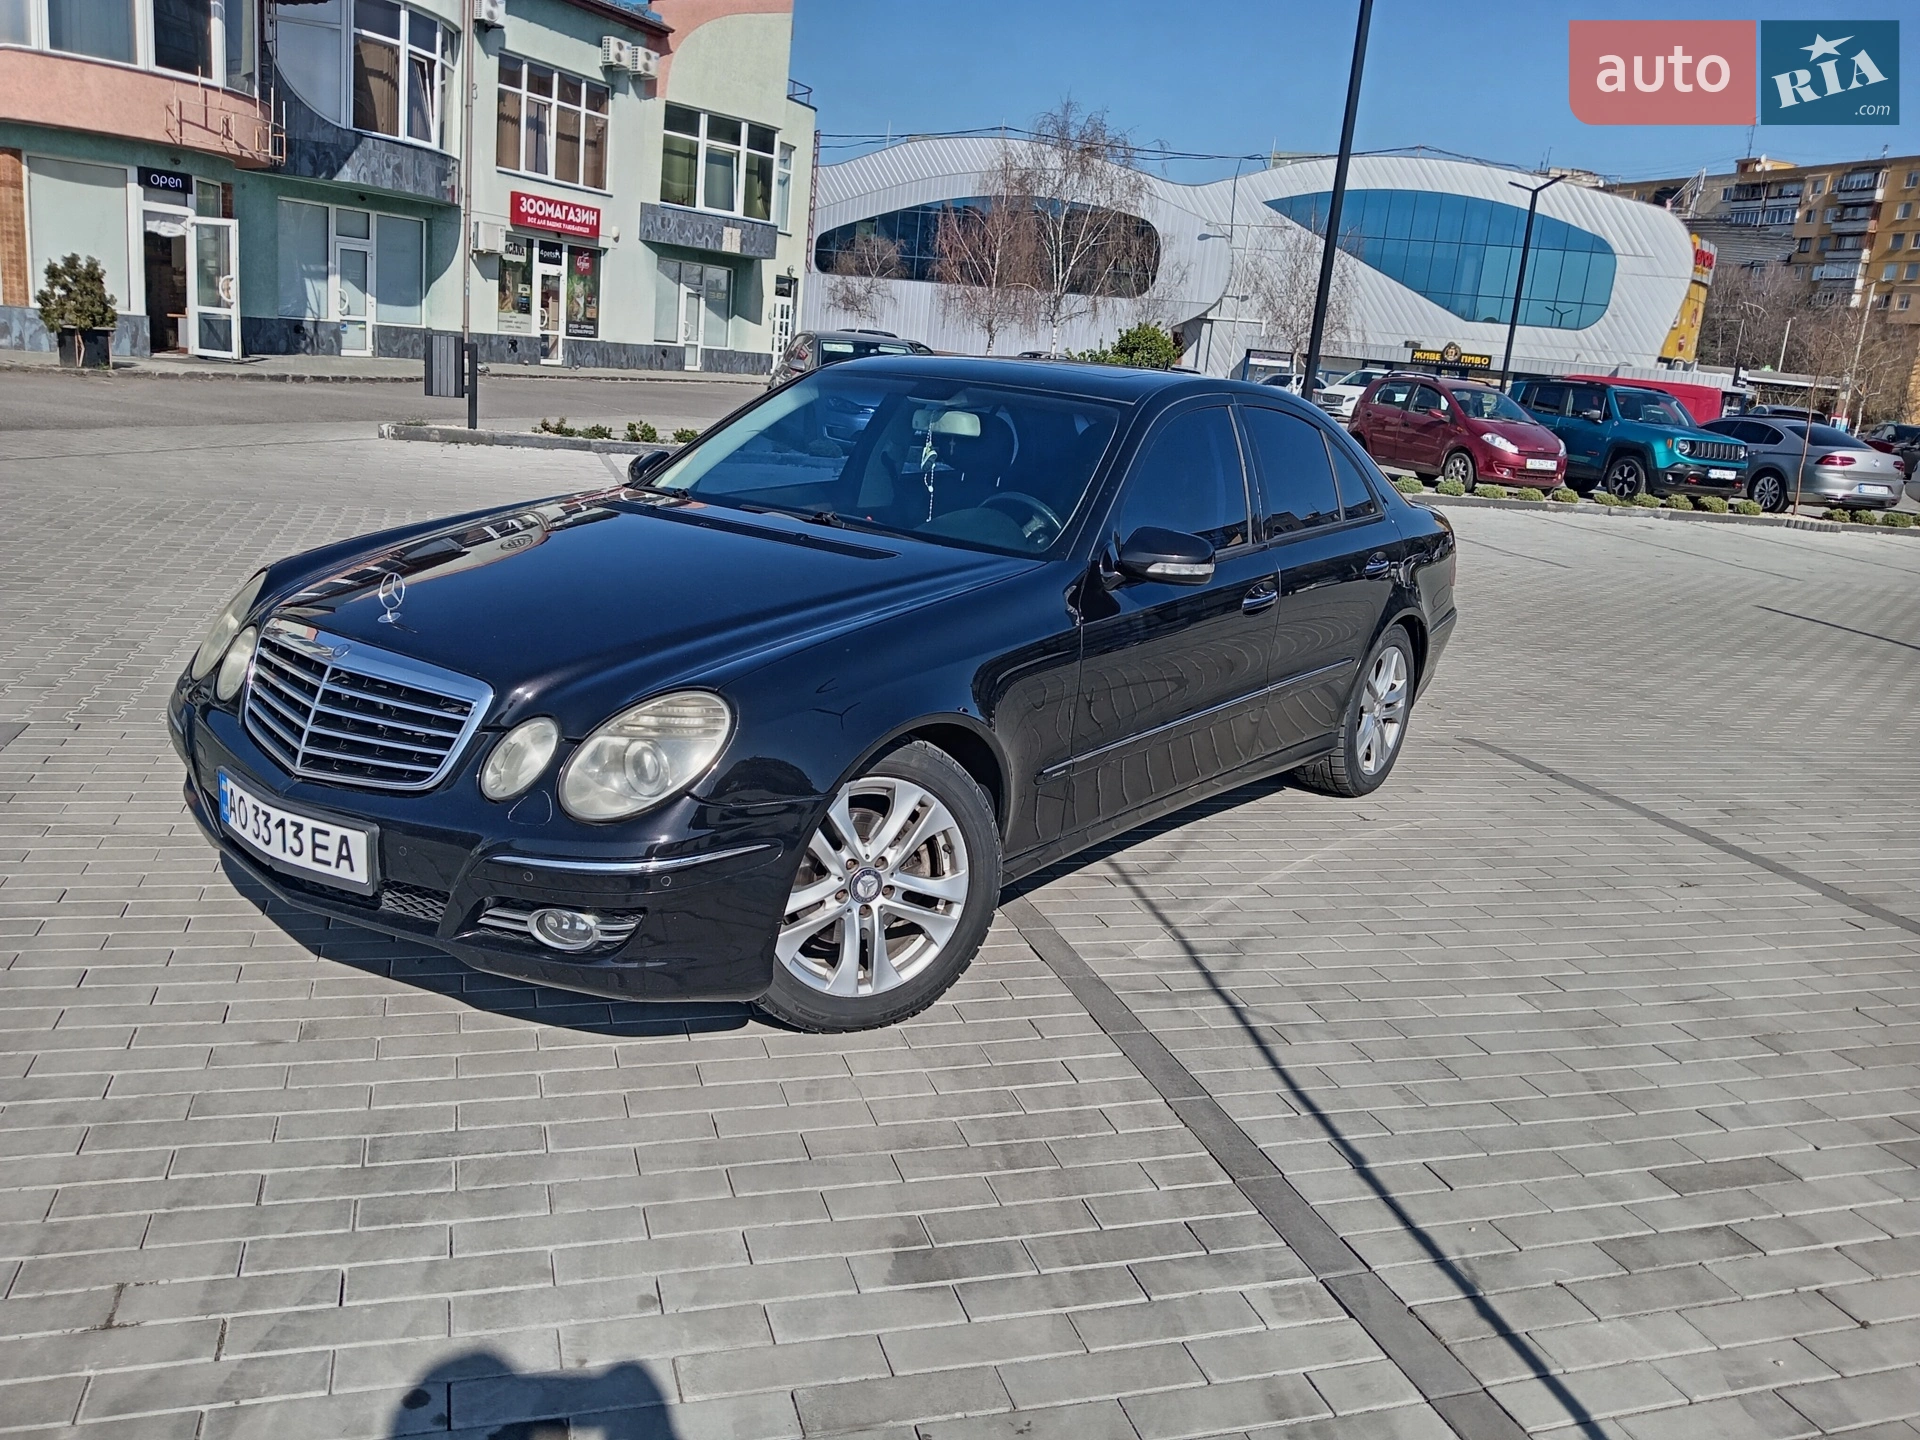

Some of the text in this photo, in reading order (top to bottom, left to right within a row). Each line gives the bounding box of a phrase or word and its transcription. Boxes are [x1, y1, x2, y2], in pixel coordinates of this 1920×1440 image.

[519, 196, 598, 226] ЗООМАГАЗИН
[527, 216, 537, 224] ВСЕ
[536, 217, 546, 226] ДЛЯ
[1413, 351, 1489, 365] ЖИВЕ ПИВО
[229, 788, 355, 873] AO 3313 EA
